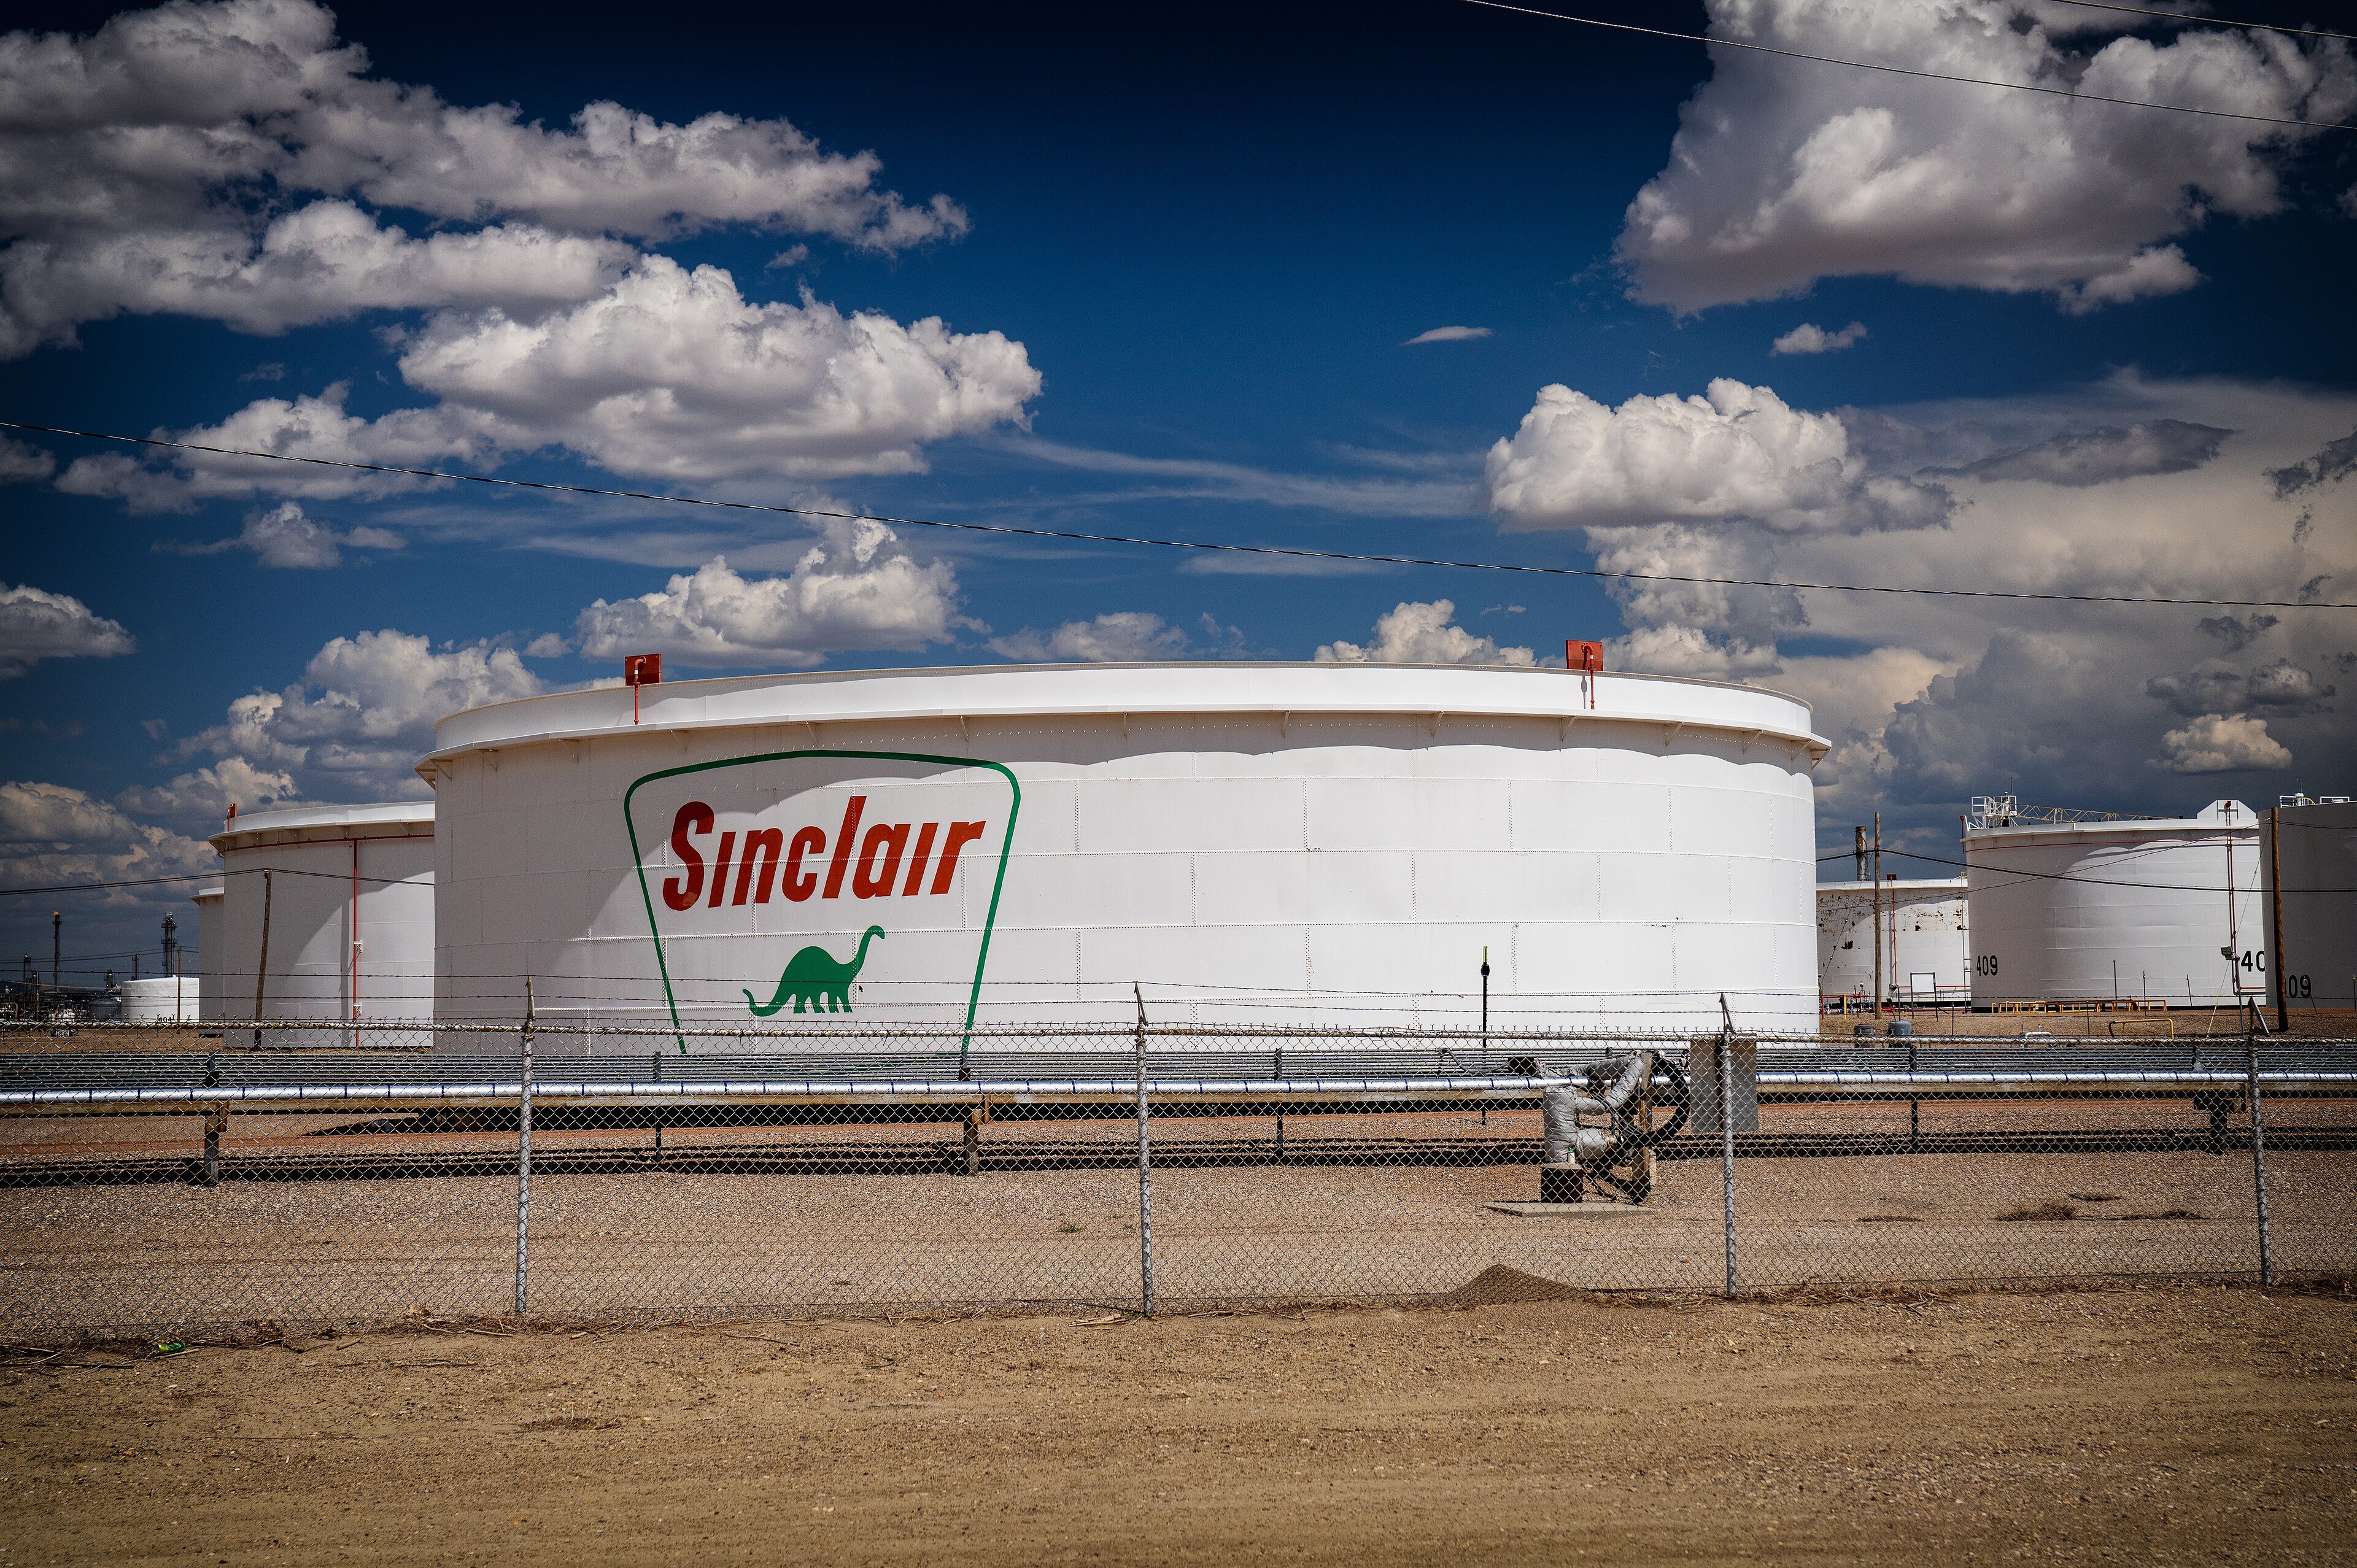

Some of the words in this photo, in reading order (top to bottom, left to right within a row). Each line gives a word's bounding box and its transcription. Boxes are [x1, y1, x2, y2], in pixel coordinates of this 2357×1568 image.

[663, 796, 986, 911] Sinclair
[1976, 955, 1998, 976] 409
[2283, 975, 2312, 999] 09
